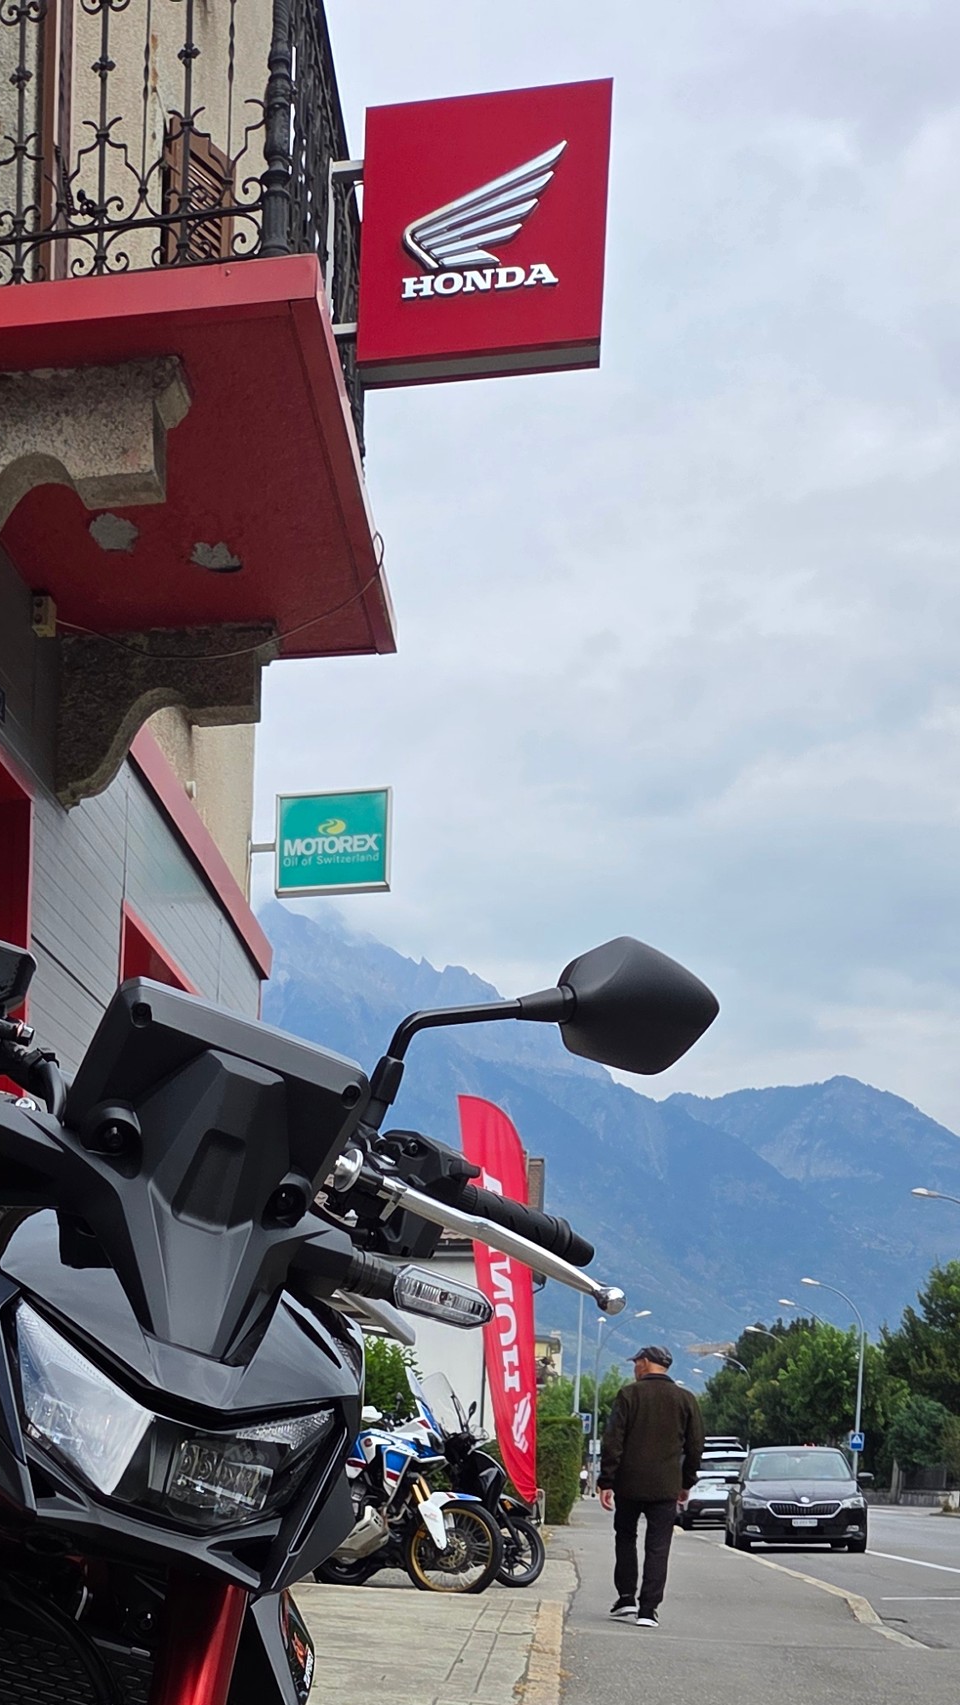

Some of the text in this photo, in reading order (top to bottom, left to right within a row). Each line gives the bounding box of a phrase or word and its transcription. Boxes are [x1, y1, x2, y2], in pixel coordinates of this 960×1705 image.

[401, 263, 559, 299] HONDA
[283, 833, 379, 857] MOTOREX
[283, 852, 380, 868] Oil of Switzerland
